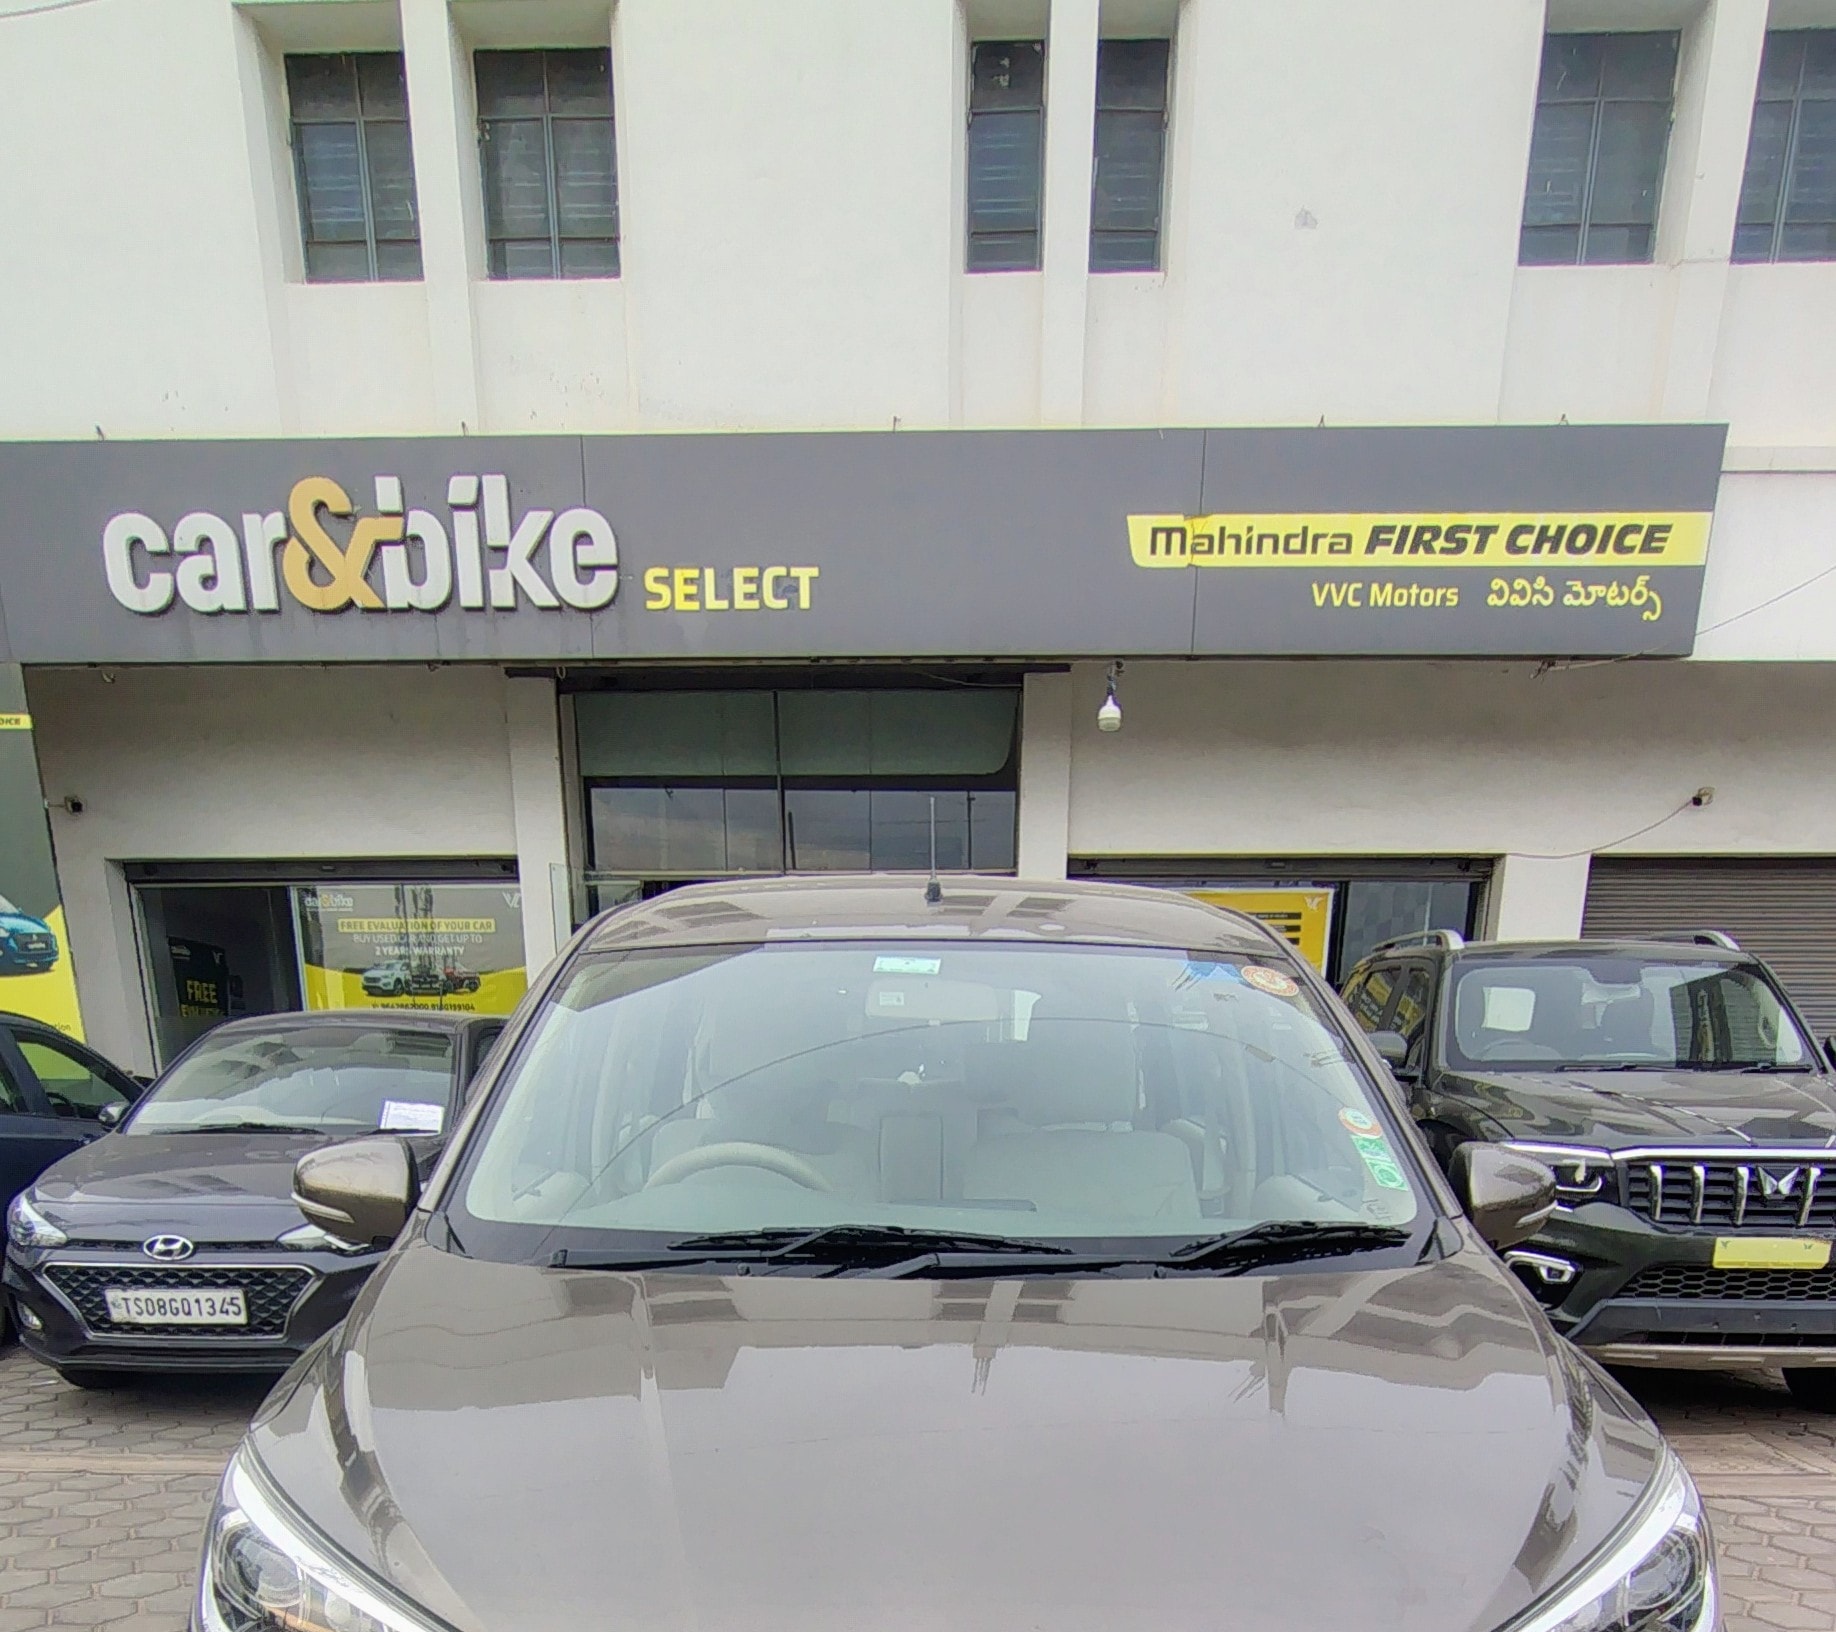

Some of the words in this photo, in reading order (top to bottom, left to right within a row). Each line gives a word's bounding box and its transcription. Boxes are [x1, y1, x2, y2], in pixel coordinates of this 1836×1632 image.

[102, 474, 619, 613] car&bike
[644, 566, 820, 611] SELECT
[1150, 526, 1353, 556] Mahindra
[1364, 523, 1500, 555] FIRST
[1504, 523, 1674, 555] CHOICE
[1311, 582, 1363, 607] VVC
[1369, 581, 1460, 608] Motors
[340, 921, 365, 930] FREE
[443, 921, 471, 930] YOUR
[472, 921, 492, 930] CAR
